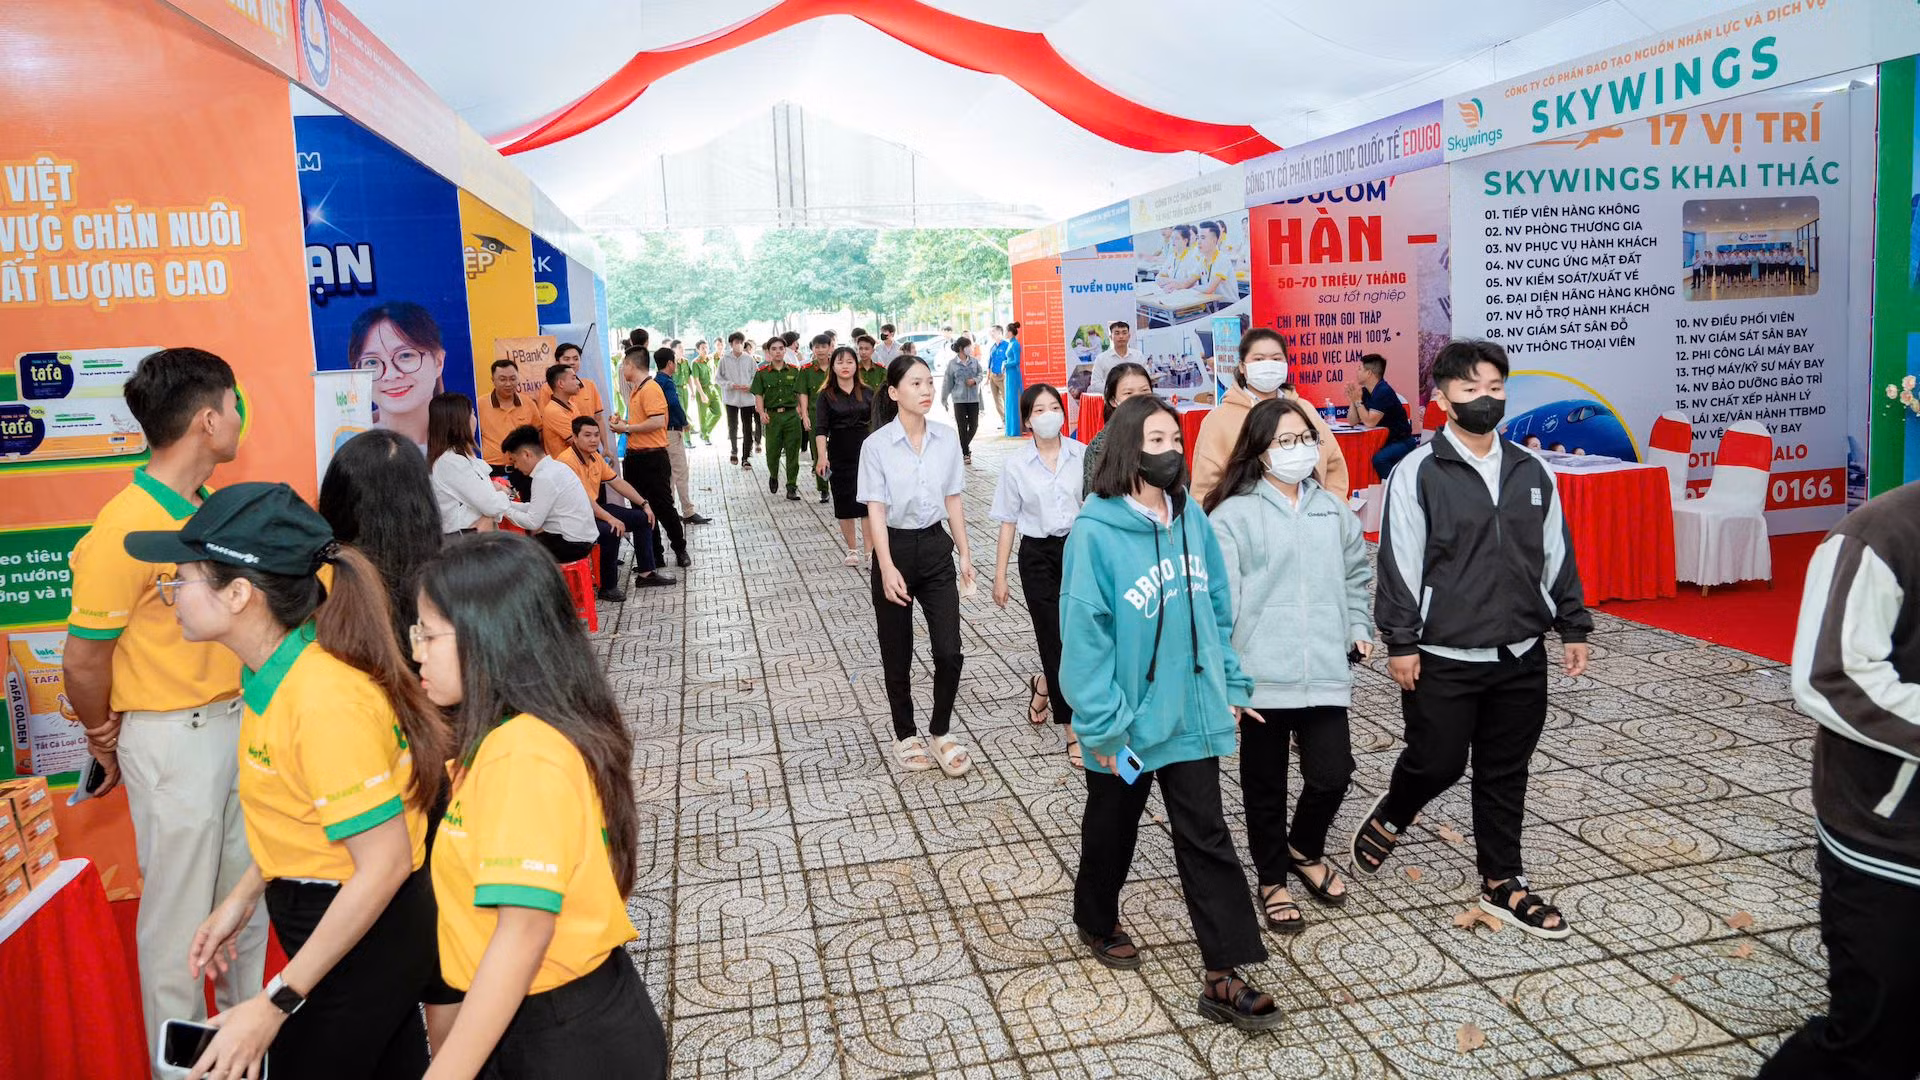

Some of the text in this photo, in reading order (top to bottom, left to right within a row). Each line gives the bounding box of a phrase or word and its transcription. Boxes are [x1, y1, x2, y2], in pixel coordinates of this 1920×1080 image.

[1530, 82, 1540, 90] TY
[1716, 20, 1741, 37] LỰC
[1745, 10, 1762, 28] VÀ
[1767, 1, 1801, 22] DỊCH
[1532, 36, 1779, 133] SKYWINGS
[1648, 102, 1824, 153] 17 VỊ TRÍ
[1448, 129, 1502, 152] Skywings
[1266, 171, 1276, 190] TY
[1314, 150, 1334, 180] GIÁO
[1337, 153, 1355, 176] DỤC
[1358, 132, 1384, 168] QUỐC
[1387, 125, 1401, 160] TẾ
[1403, 122, 1440, 157] EDUGO
[4, 157, 72, 209] VIỆT
[1484, 156, 1840, 195] SKYWINGS KHAI THÁC
[1485, 204, 1640, 219] 01. TIẾP VIÊN HÀNG KHÔNG
[0, 202, 241, 259] VỰC CHĂN NUÔI
[1268, 207, 1382, 265] HÀN
[1485, 221, 1642, 236] 02. NV PHÒNG THƯƠNG GIA
[1486, 236, 1657, 253] 03. NV PHỤC VỤ HÀNH KHÁCH
[1486, 252, 1642, 271] 04. NV CUNG ỨNG MẶT ĐẤT
[49, 261, 156, 307] LƯỢNG
[165, 259, 227, 296] CAO
[1070, 279, 1133, 294] TUYỂN DỤNG
[1486, 278, 1502, 287] 05.
[1506, 277, 1523, 286] NV
[1558, 270, 1621, 284] SOÁT/XUẤT
[1318, 288, 1406, 303] sau tốt nghiệp
[1486, 284, 1675, 305] 06. ĐẠI DIỆN HÃNG HÀNG KHÔNG
[1486, 303, 1649, 321] 07. NV HỖ TRỢ HÀNH KHÁCH
[1676, 319, 1690, 328] 10.
[1693, 318, 1709, 327] NV
[1741, 311, 1767, 324] PHỐI
[1770, 311, 1795, 323] VIÊN
[1277, 316, 1292, 328] CHI
[1486, 317, 1628, 338] 08. NV GIÁM SÁT SÂN ĐỖ
[1366, 328, 1391, 343] 100%
[1507, 335, 1635, 354] NV THÔNG THOẠI VIÊN
[1676, 328, 1808, 344] 11. NV GIÁM SÁT SÂN BAY
[1676, 344, 1814, 361] 12. PHI CÔNG LÁI MÁY BAY
[31, 364, 62, 381] tafa
[1326, 370, 1343, 382] CAO
[1676, 358, 1824, 378] 13. THỢ MÁY/KỸ SƯ MÁY BAY
[1676, 373, 1822, 393] 14. NV BẢO DƯỠNG BẢO TRÌ
[1676, 389, 1811, 409] 15. NV CHẤT XẾP HÀNH LÝ
[1693, 412, 1709, 424] LÁI
[1756, 407, 1786, 419] HÀNH
[1789, 406, 1826, 417] TTBMD
[0, 419, 33, 434] tafa
[1692, 431, 1707, 440] NV
[1766, 424, 1777, 434] ÁY
[1781, 423, 1802, 433] BAY
[1774, 444, 1808, 461] ALO
[1772, 476, 1832, 502] 0166
[26, 550, 62, 563] tiêu
[12, 568, 70, 582] nướng
[35, 586, 56, 599] và
[33, 675, 60, 684] TAFA
[9, 678, 27, 744] TAFA GOLDEN
